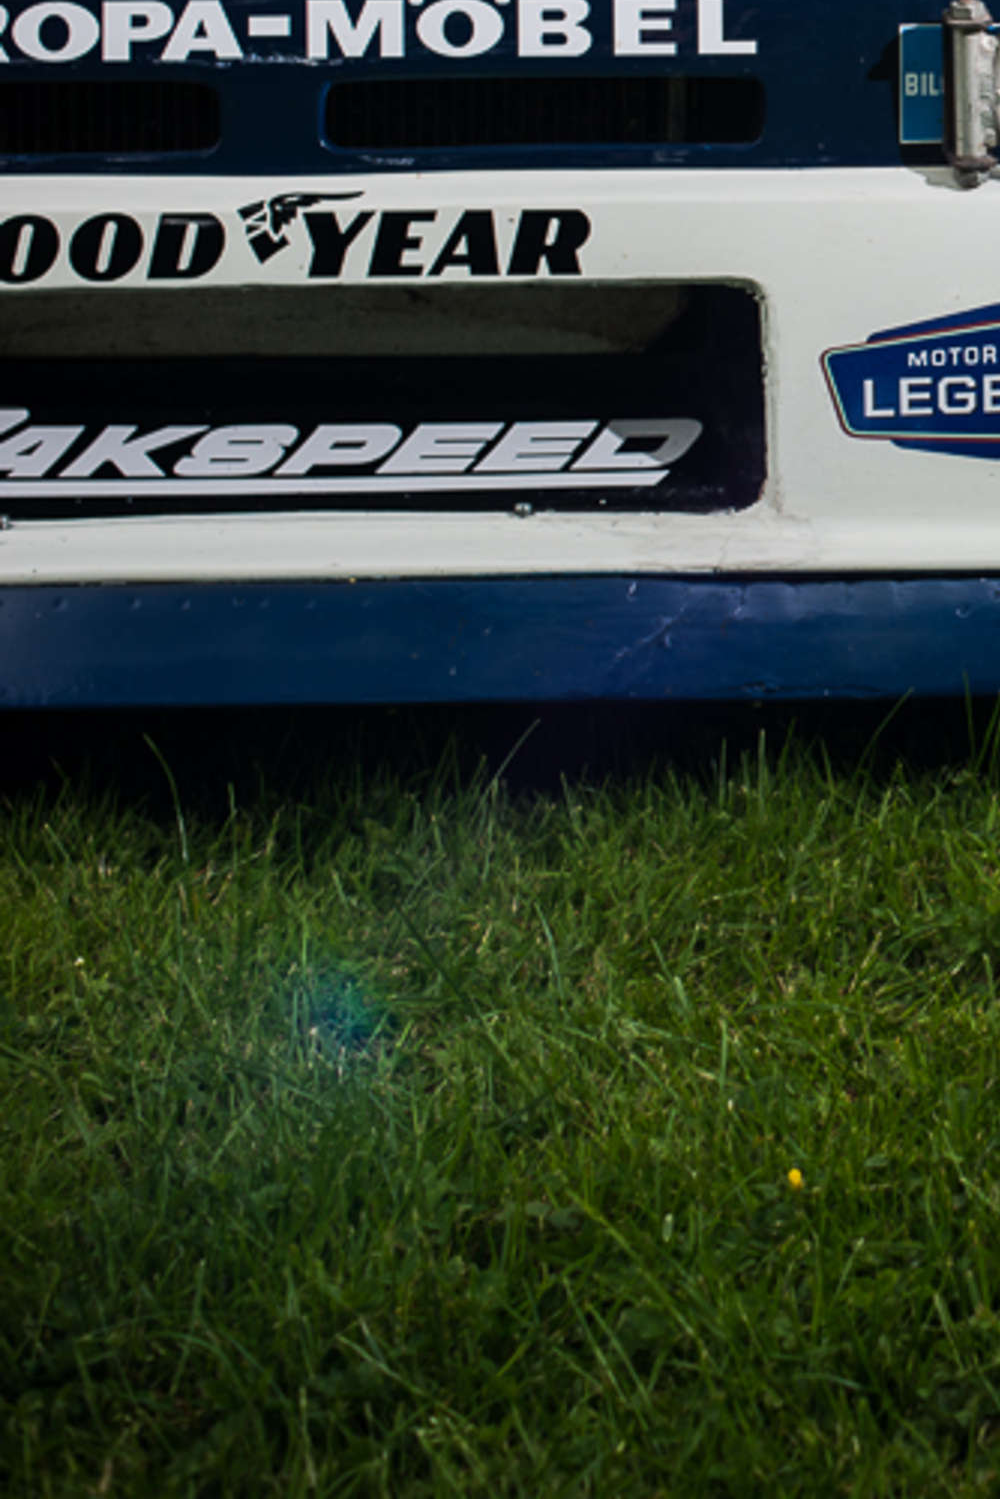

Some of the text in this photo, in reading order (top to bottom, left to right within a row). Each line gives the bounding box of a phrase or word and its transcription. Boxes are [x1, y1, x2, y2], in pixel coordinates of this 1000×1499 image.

[904, 71, 944, 97] BIL
[302, 207, 592, 278] YEAR
[907, 345, 998, 368] MOTOR
